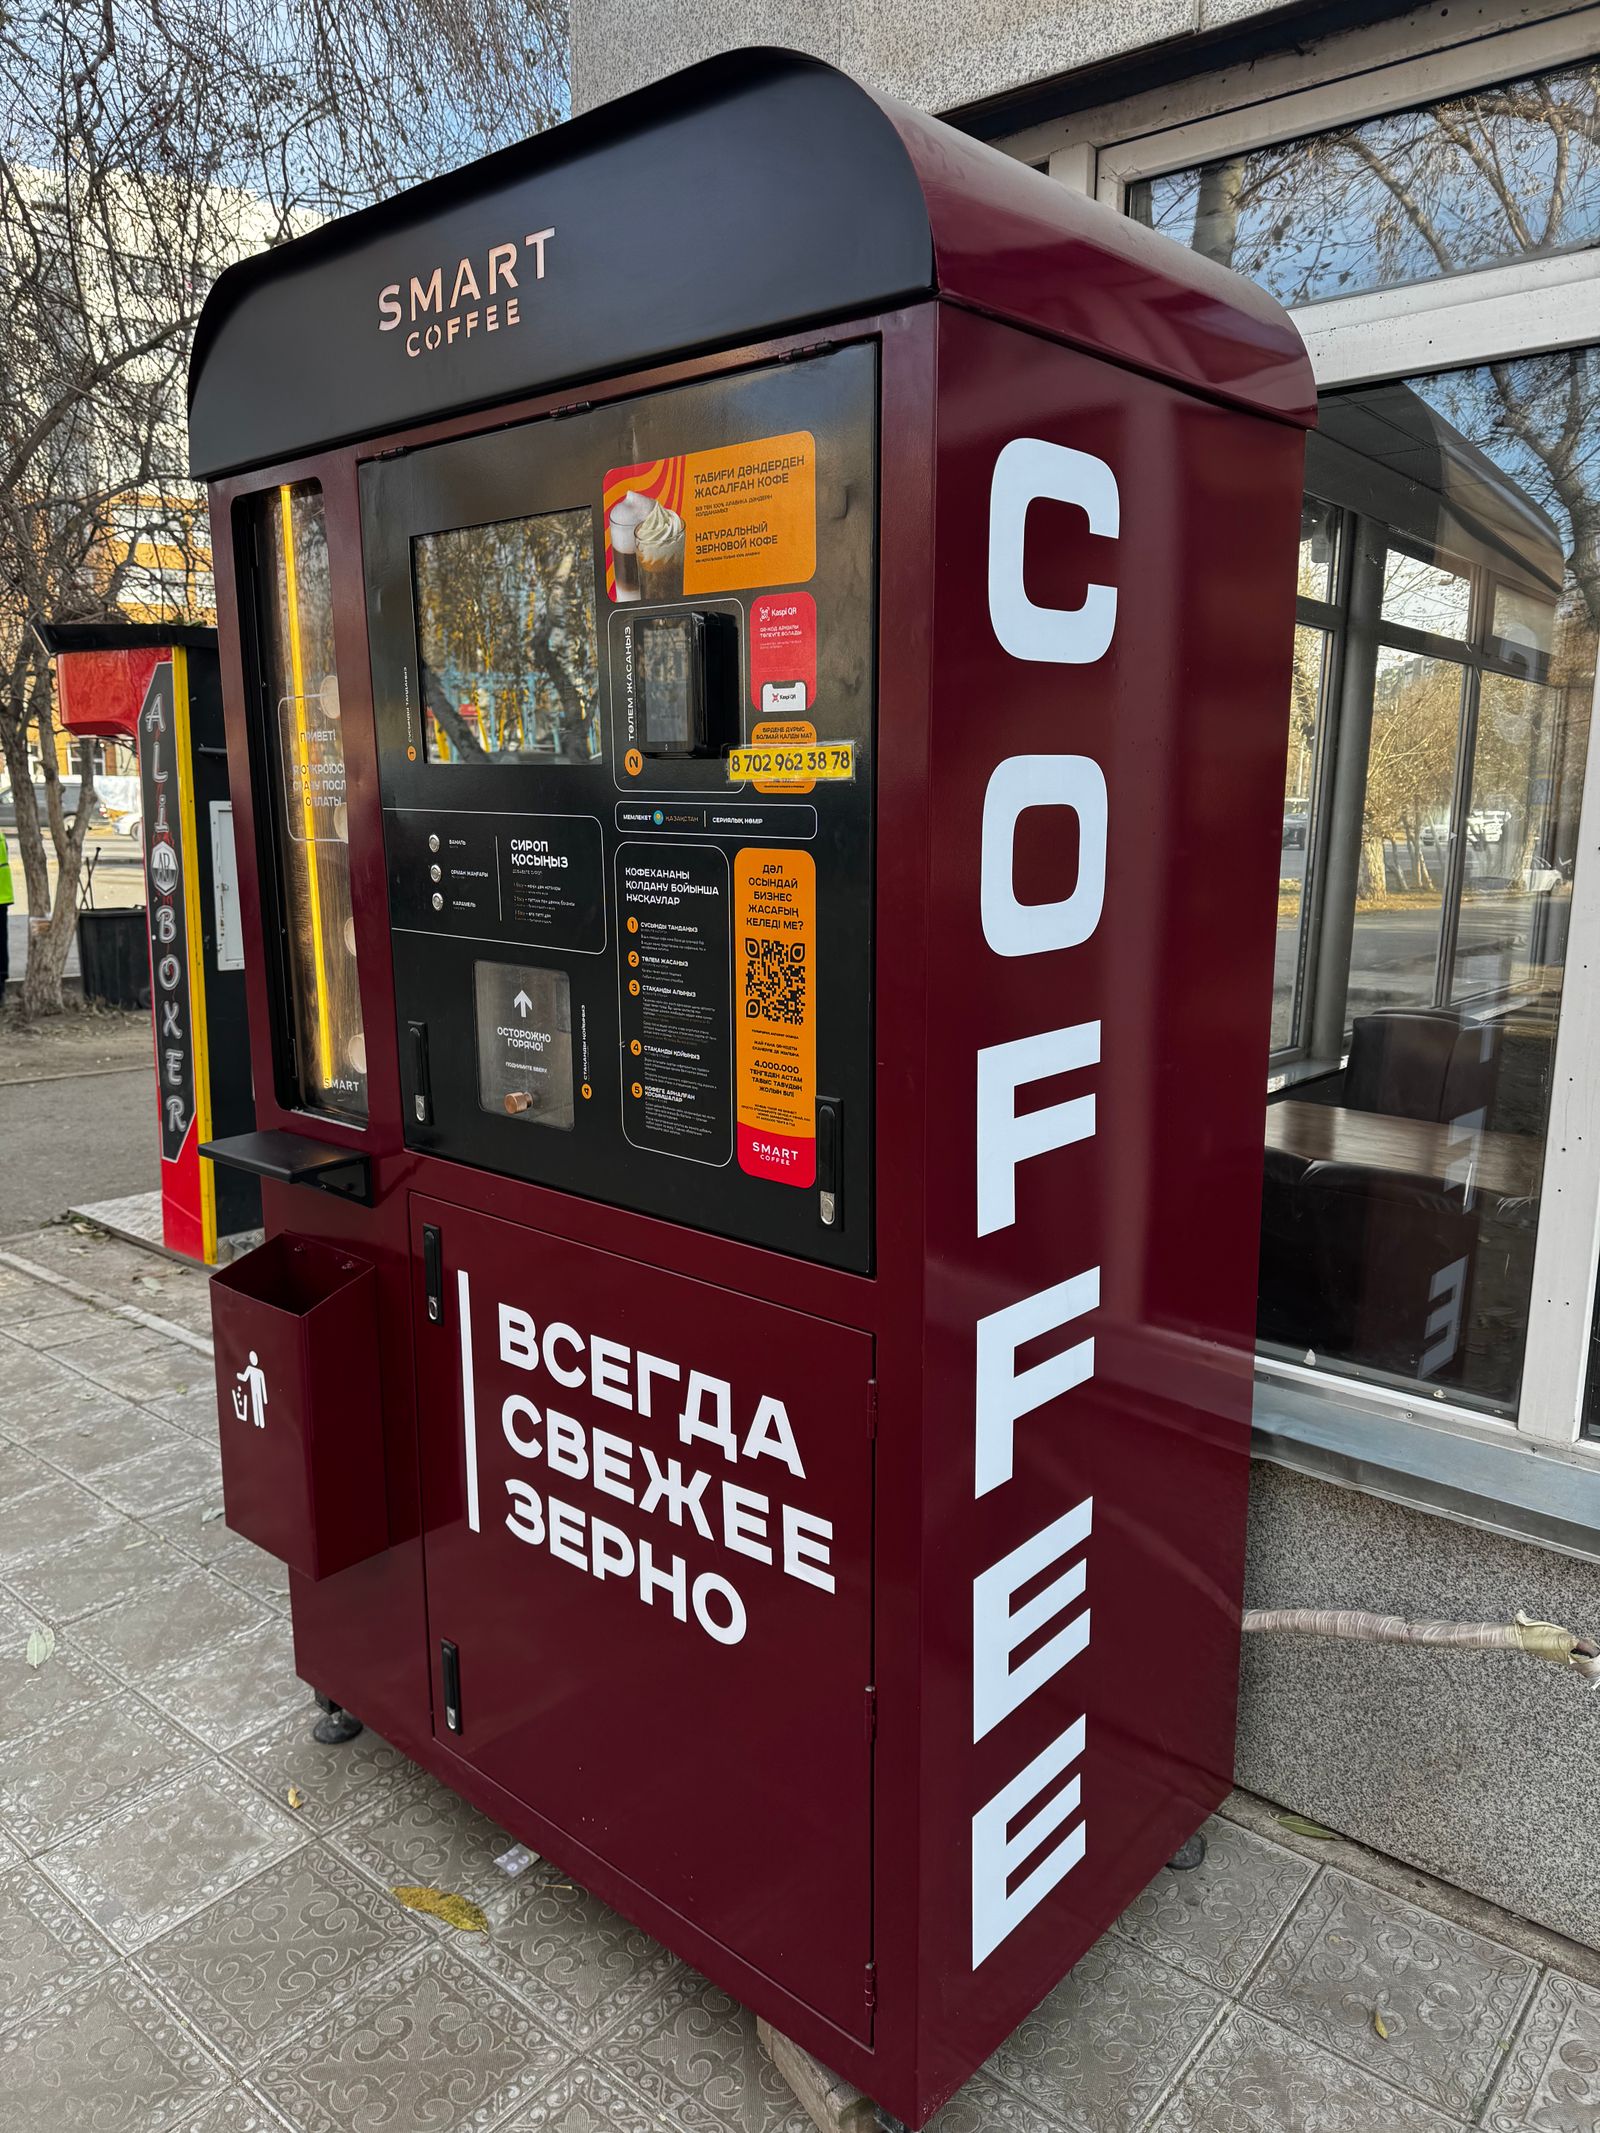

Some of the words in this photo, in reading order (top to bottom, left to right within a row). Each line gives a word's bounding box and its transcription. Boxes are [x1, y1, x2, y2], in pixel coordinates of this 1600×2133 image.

[378, 227, 555, 331] SMART
[406, 298, 520, 357] COFFEE
[694, 468, 735, 485] ТАБИҒИ
[737, 455, 805, 479] ДӘНДЕРДЕН
[694, 479, 755, 499] ЖАСАЛҒАН
[757, 472, 789, 488] КОФЕ
[695, 521, 768, 542] НАТУРАЛЬНЫЙ
[695, 537, 748, 555] ЗЕРНОВОЙ
[749, 535, 778, 548] КОФЕ
[771, 607, 787, 618] Kaspi
[788, 606, 797, 616] QR
[625, 626, 633, 693] ЖАСАҢЫЗ
[629, 756, 638, 768] 2
[731, 755, 741, 772] 8
[744, 754, 772, 772] 702
[775, 752, 803, 771] 962
[807, 751, 827, 770] 38
[831, 750, 850, 769] 78
[510, 838, 549, 853] СИРОП
[511, 853, 569, 869] ҚОСЫҢЫЗ
[762, 864, 783, 874] ДӘЛ
[625, 867, 690, 880] КОФЕХАНАНЫ
[625, 880, 669, 892] ҚОЛДАНУ
[671, 882, 720, 896] БОЙЫНША
[748, 877, 798, 889] ОСЫНДАЙ
[626, 893, 681, 906] НҰСҚАУЛАР
[753, 891, 793, 902] БИЗНЕС
[748, 904, 799, 918] ЖАСАҒЫҢ
[746, 917, 781, 929] КЕЛЕДІ
[783, 920, 804, 931] МЕ?
[155, 904, 187, 1133] BOXER
[497, 1026, 552, 1043] ОСТОРОЖНО
[507, 1037, 544, 1052] ГОРЯЧО!
[754, 1059, 800, 1074] 4.000.000
[324, 1077, 360, 1092] SMART
[781, 1074, 803, 1083] АСТАМ
[752, 1141, 799, 1161] SMART
[760, 1154, 790, 1166] COFFEE
[972, 437, 1120, 1971] COFFEE
[498, 1302, 807, 1479] ВСЕГДА
[501, 1394, 835, 1595] СВЕЖЕЕ
[504, 1478, 747, 1645] ЗЕРНО
